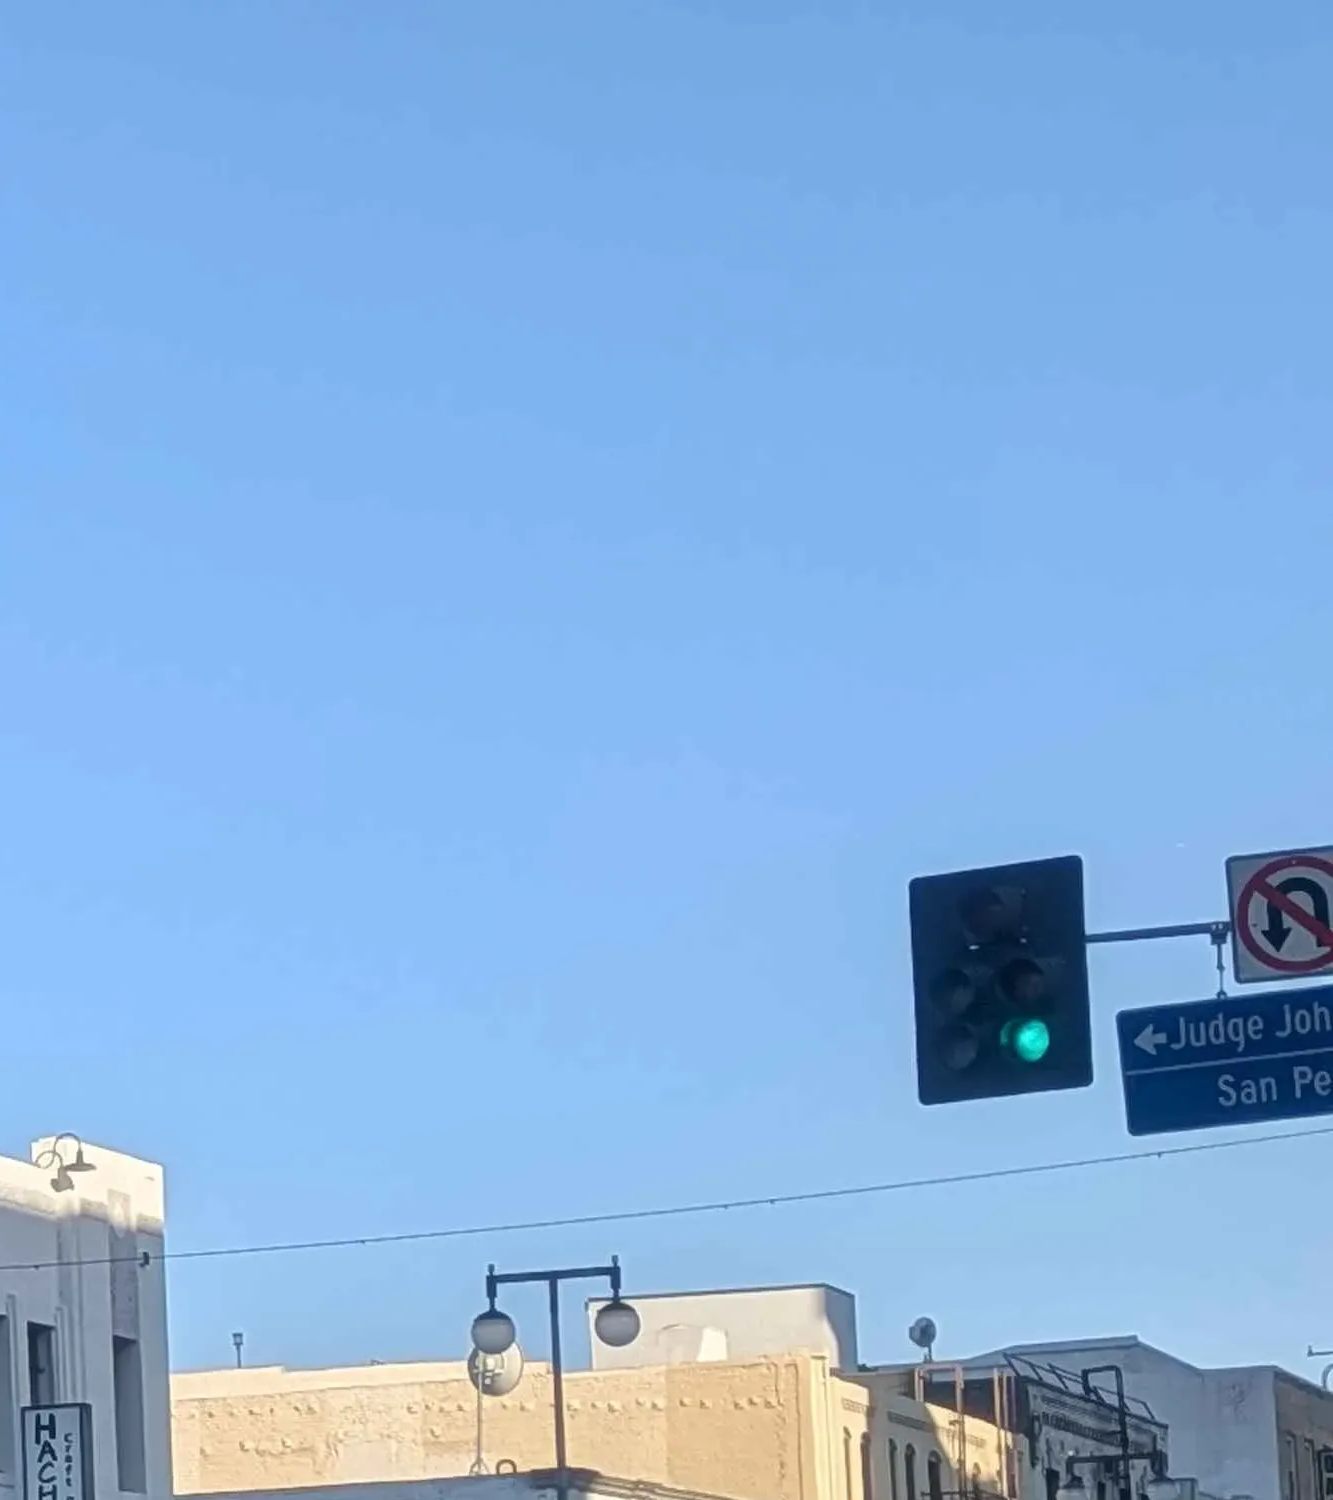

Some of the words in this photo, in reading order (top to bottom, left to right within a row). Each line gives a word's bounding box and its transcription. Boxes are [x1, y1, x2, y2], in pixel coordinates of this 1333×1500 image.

[1169, 1013, 1264, 1052] Judge
[1275, 1001, 1332, 1038] Joh
[1217, 1074, 1278, 1106] San
[1292, 1066, 1332, 1099] Pe
[63, 1433, 73, 1487] Craft
